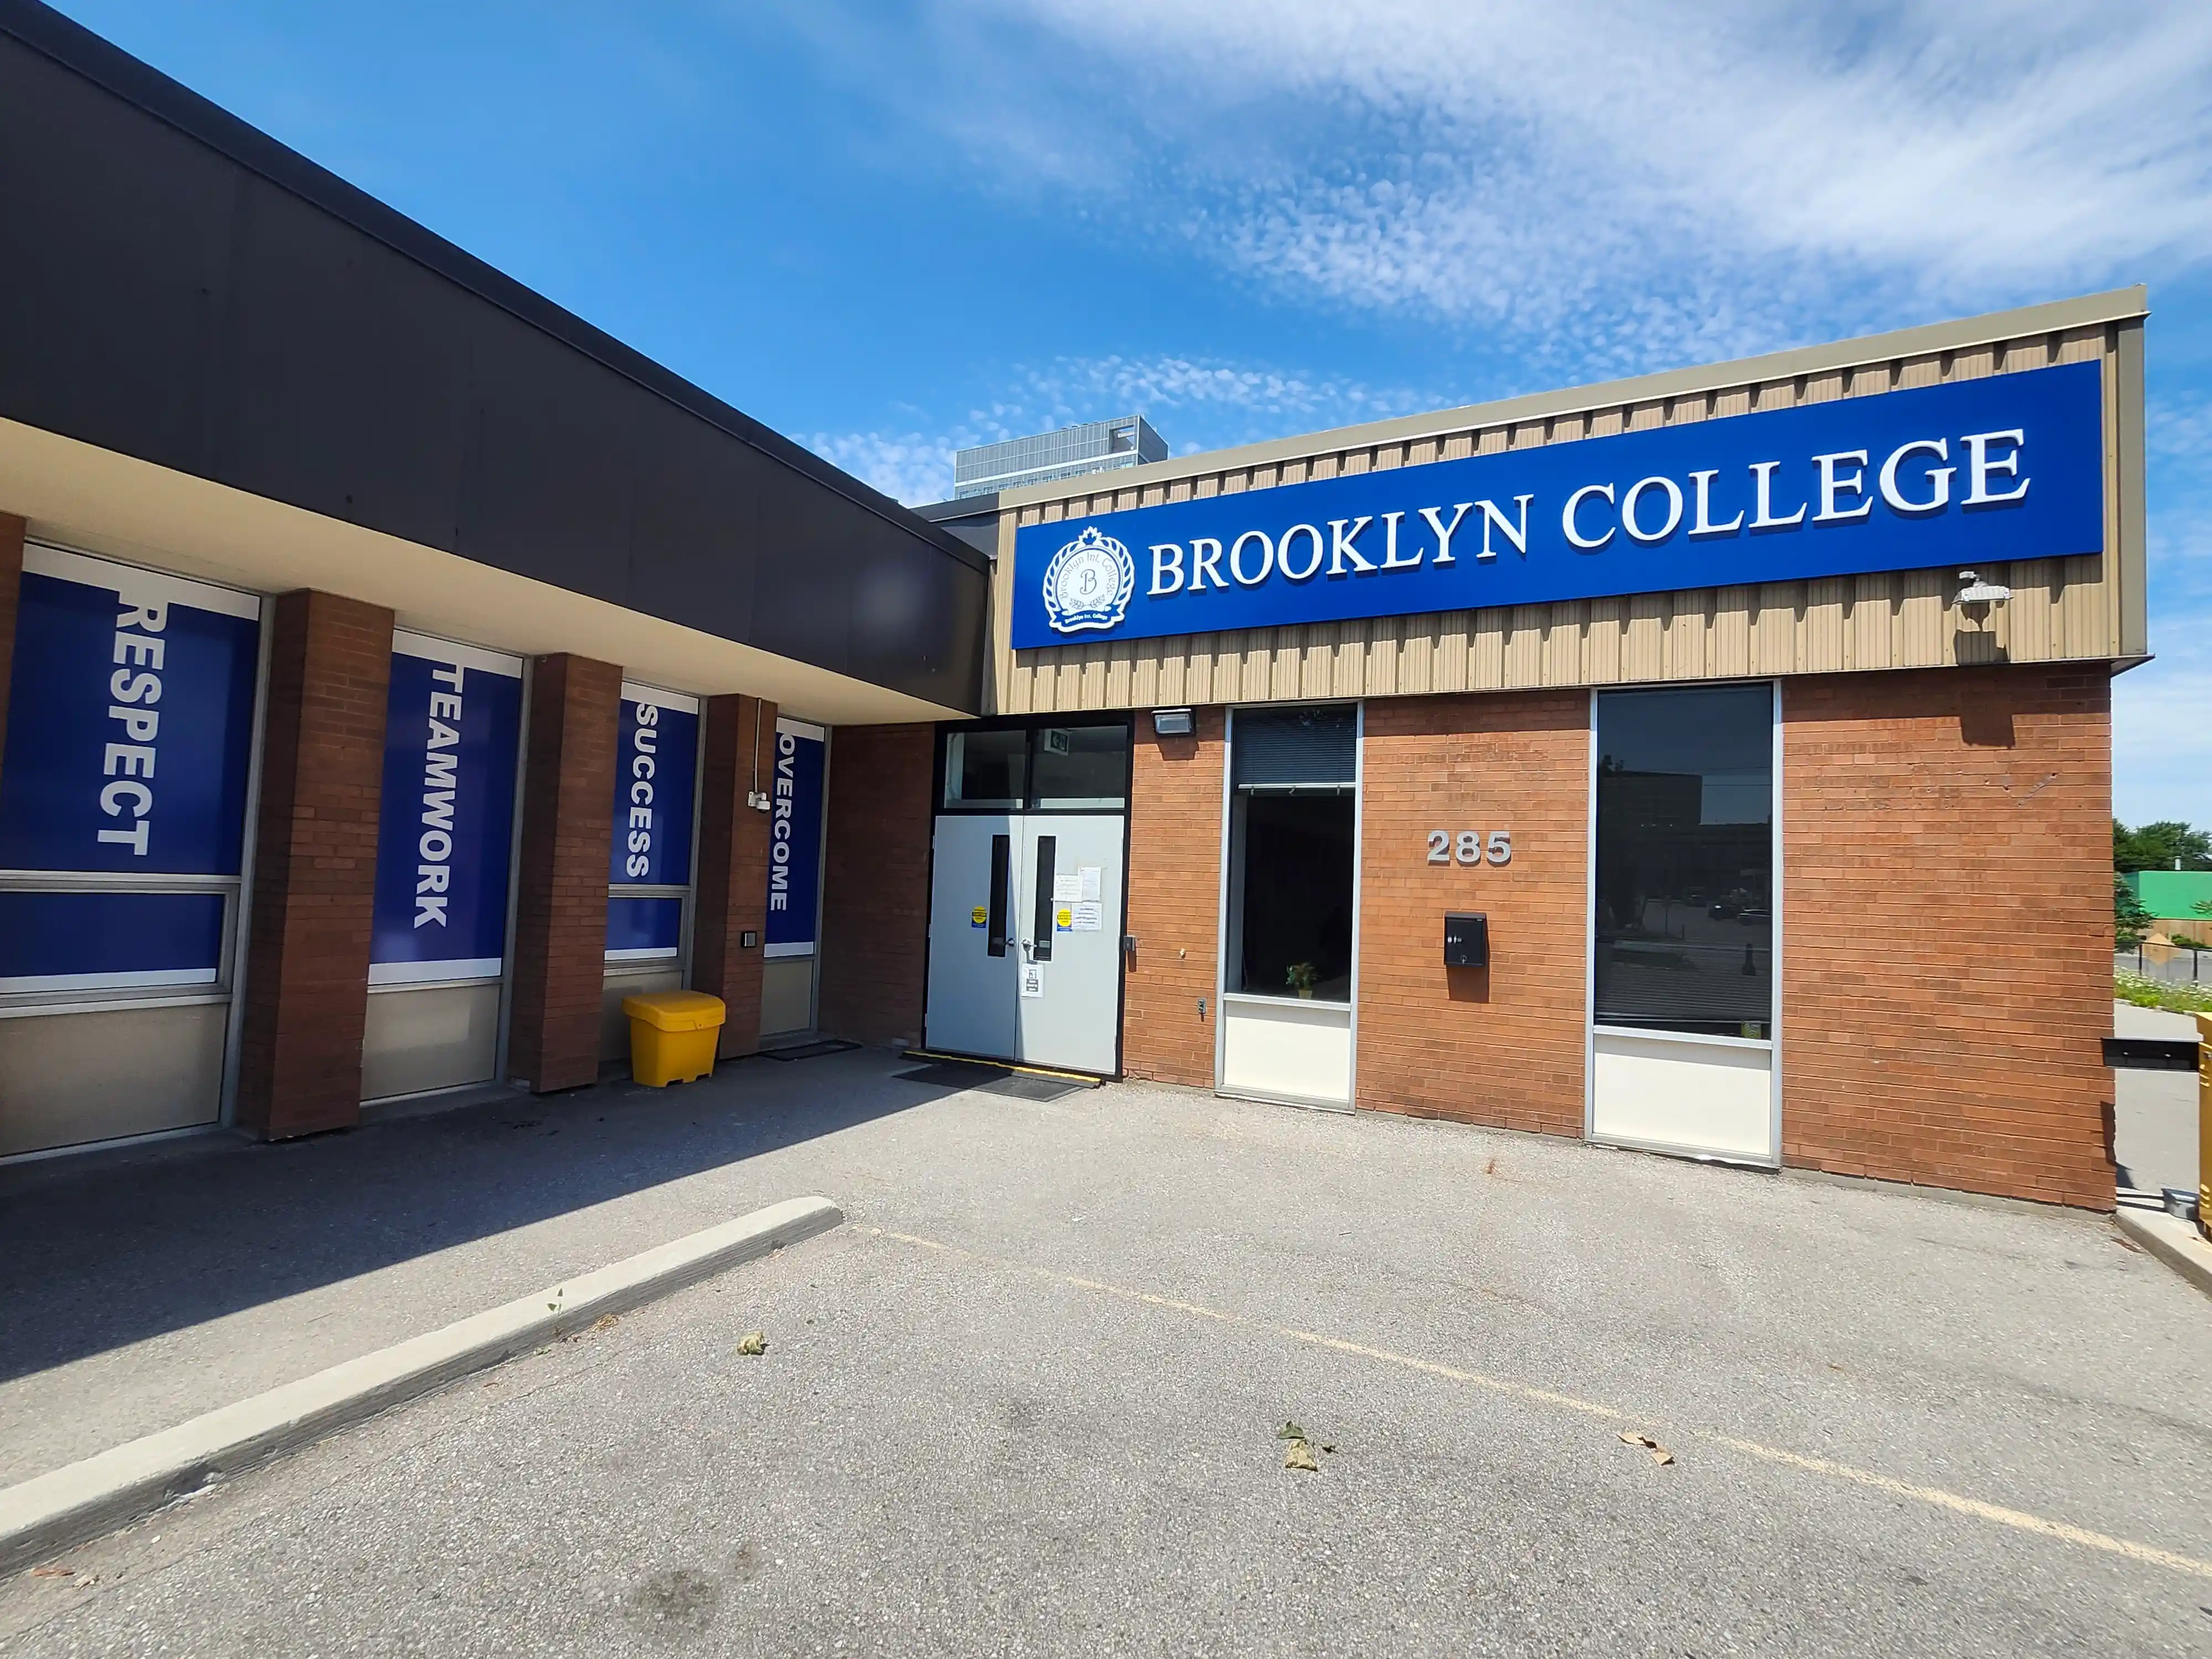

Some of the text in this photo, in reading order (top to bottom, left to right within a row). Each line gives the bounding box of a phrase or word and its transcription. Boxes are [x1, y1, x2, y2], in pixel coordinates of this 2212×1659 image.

[1059, 552, 1117, 601] Brooklyn Int. College
[1079, 569, 1097, 595] B
[1146, 429, 2031, 596] BROOKLYN COLLEGE
[97, 589, 170, 856] RESPECT
[414, 664, 465, 930] TEAMWORK
[626, 702, 658, 878] SUCCESS
[770, 732, 795, 911] OVERCOME
[1427, 830, 1511, 864] 285
